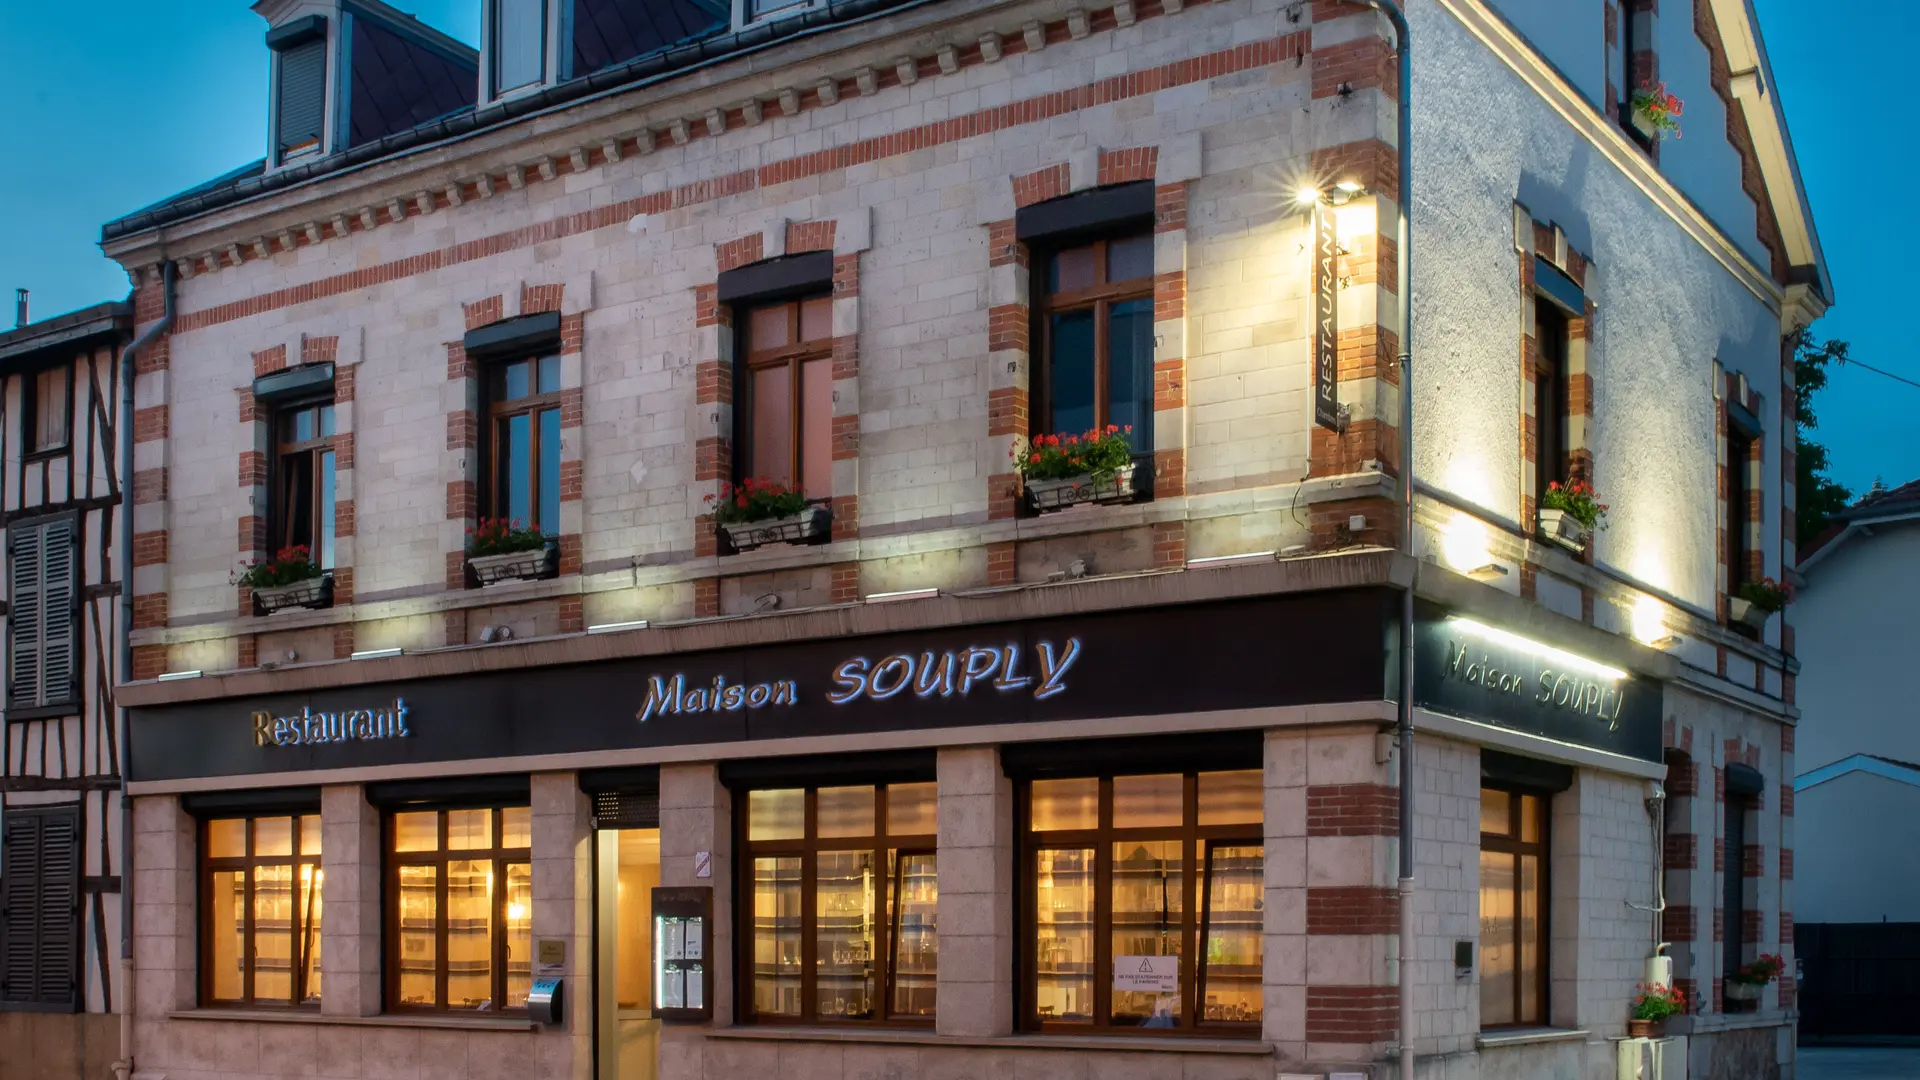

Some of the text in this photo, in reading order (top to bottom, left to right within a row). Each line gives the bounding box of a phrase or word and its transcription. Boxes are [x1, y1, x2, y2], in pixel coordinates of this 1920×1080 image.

[1321, 211, 1334, 402] RESTAURANT
[251, 696, 409, 747] Restaurant
[636, 636, 1081, 721] Maison SOUPLY
[1441, 639, 1624, 732] Maison SOUPLY
